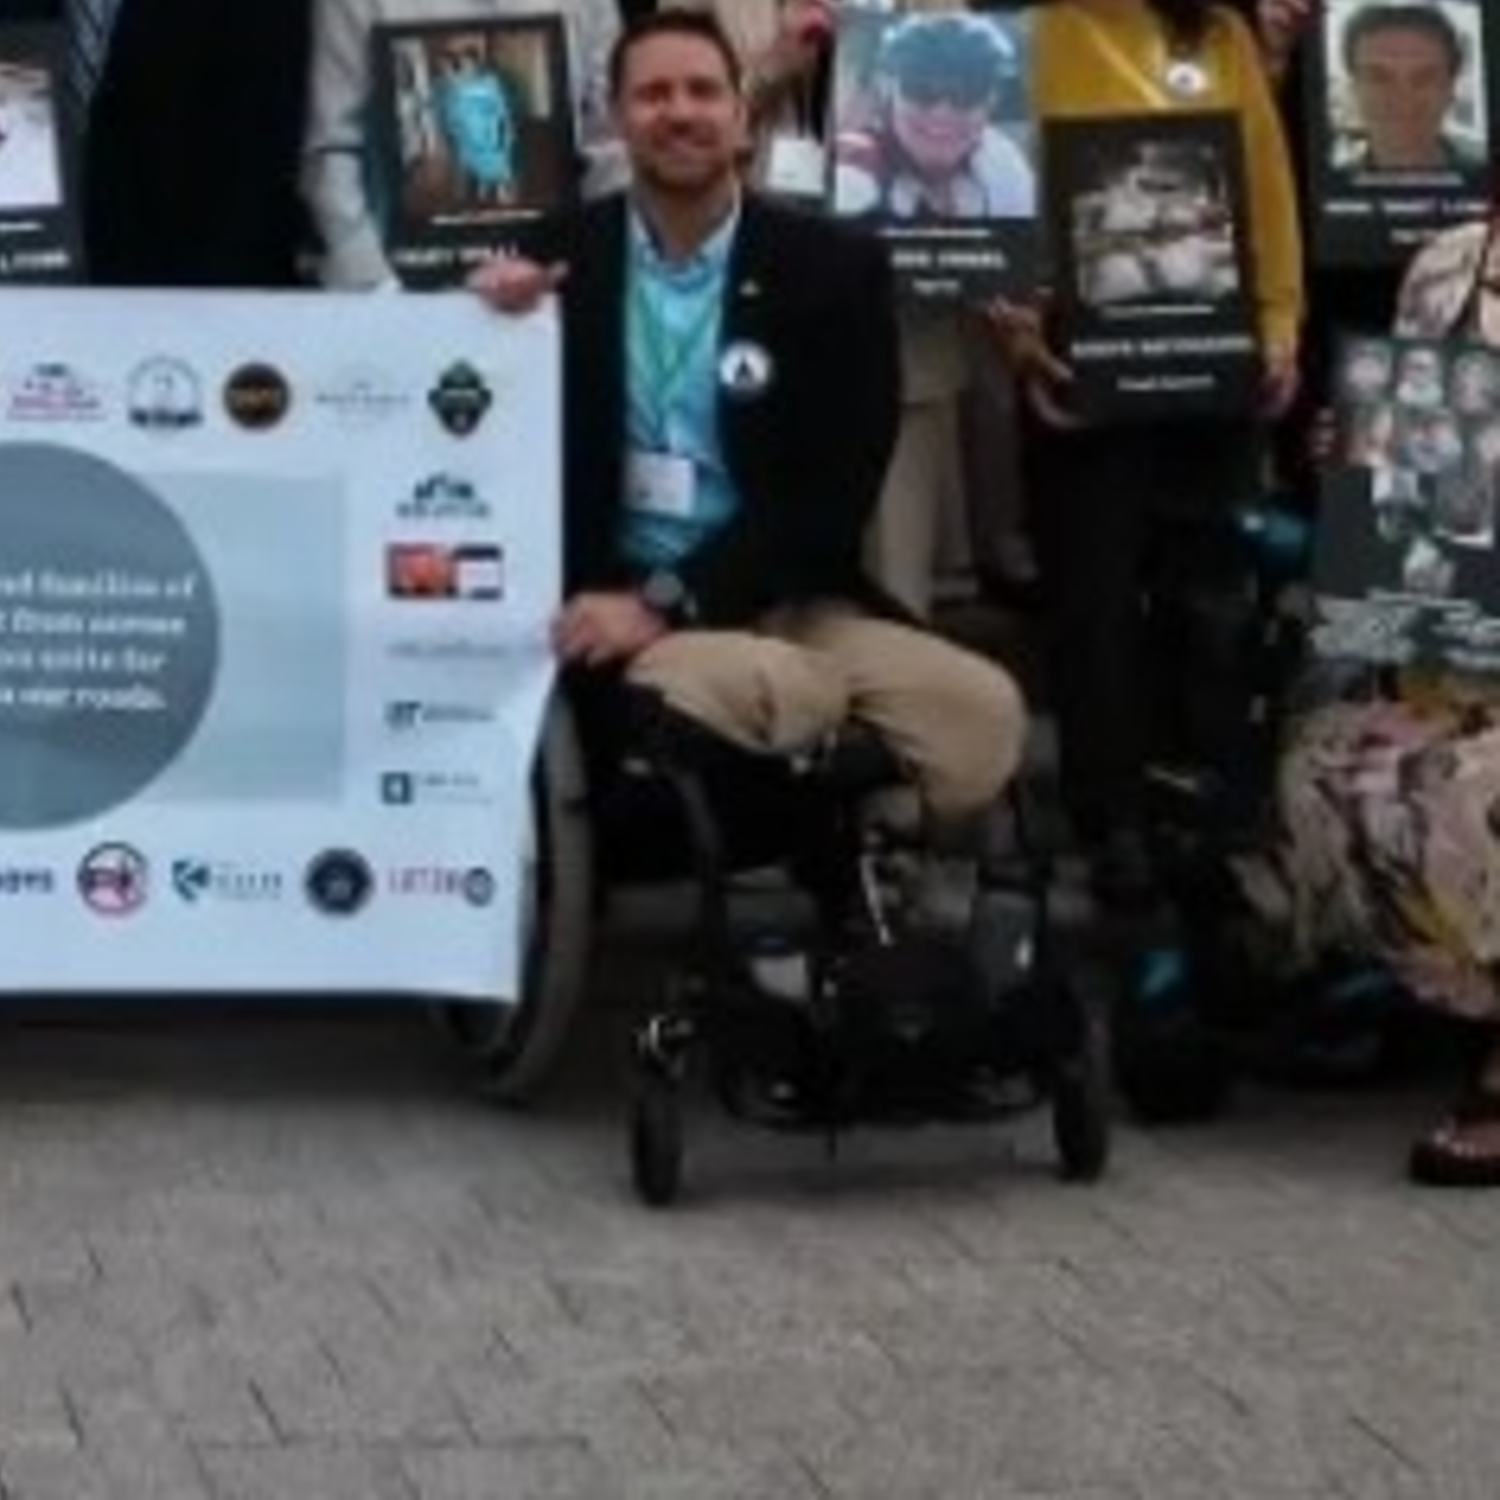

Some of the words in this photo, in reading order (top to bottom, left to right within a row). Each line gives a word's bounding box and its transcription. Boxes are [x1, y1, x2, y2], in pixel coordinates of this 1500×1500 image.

[38, 570, 159, 596] families
[164, 571, 197, 596] of
[12, 606, 83, 633] from
[88, 617, 186, 635] across
[39, 646, 113, 671] unite
[122, 647, 167, 672] for
[19, 687, 71, 706] our
